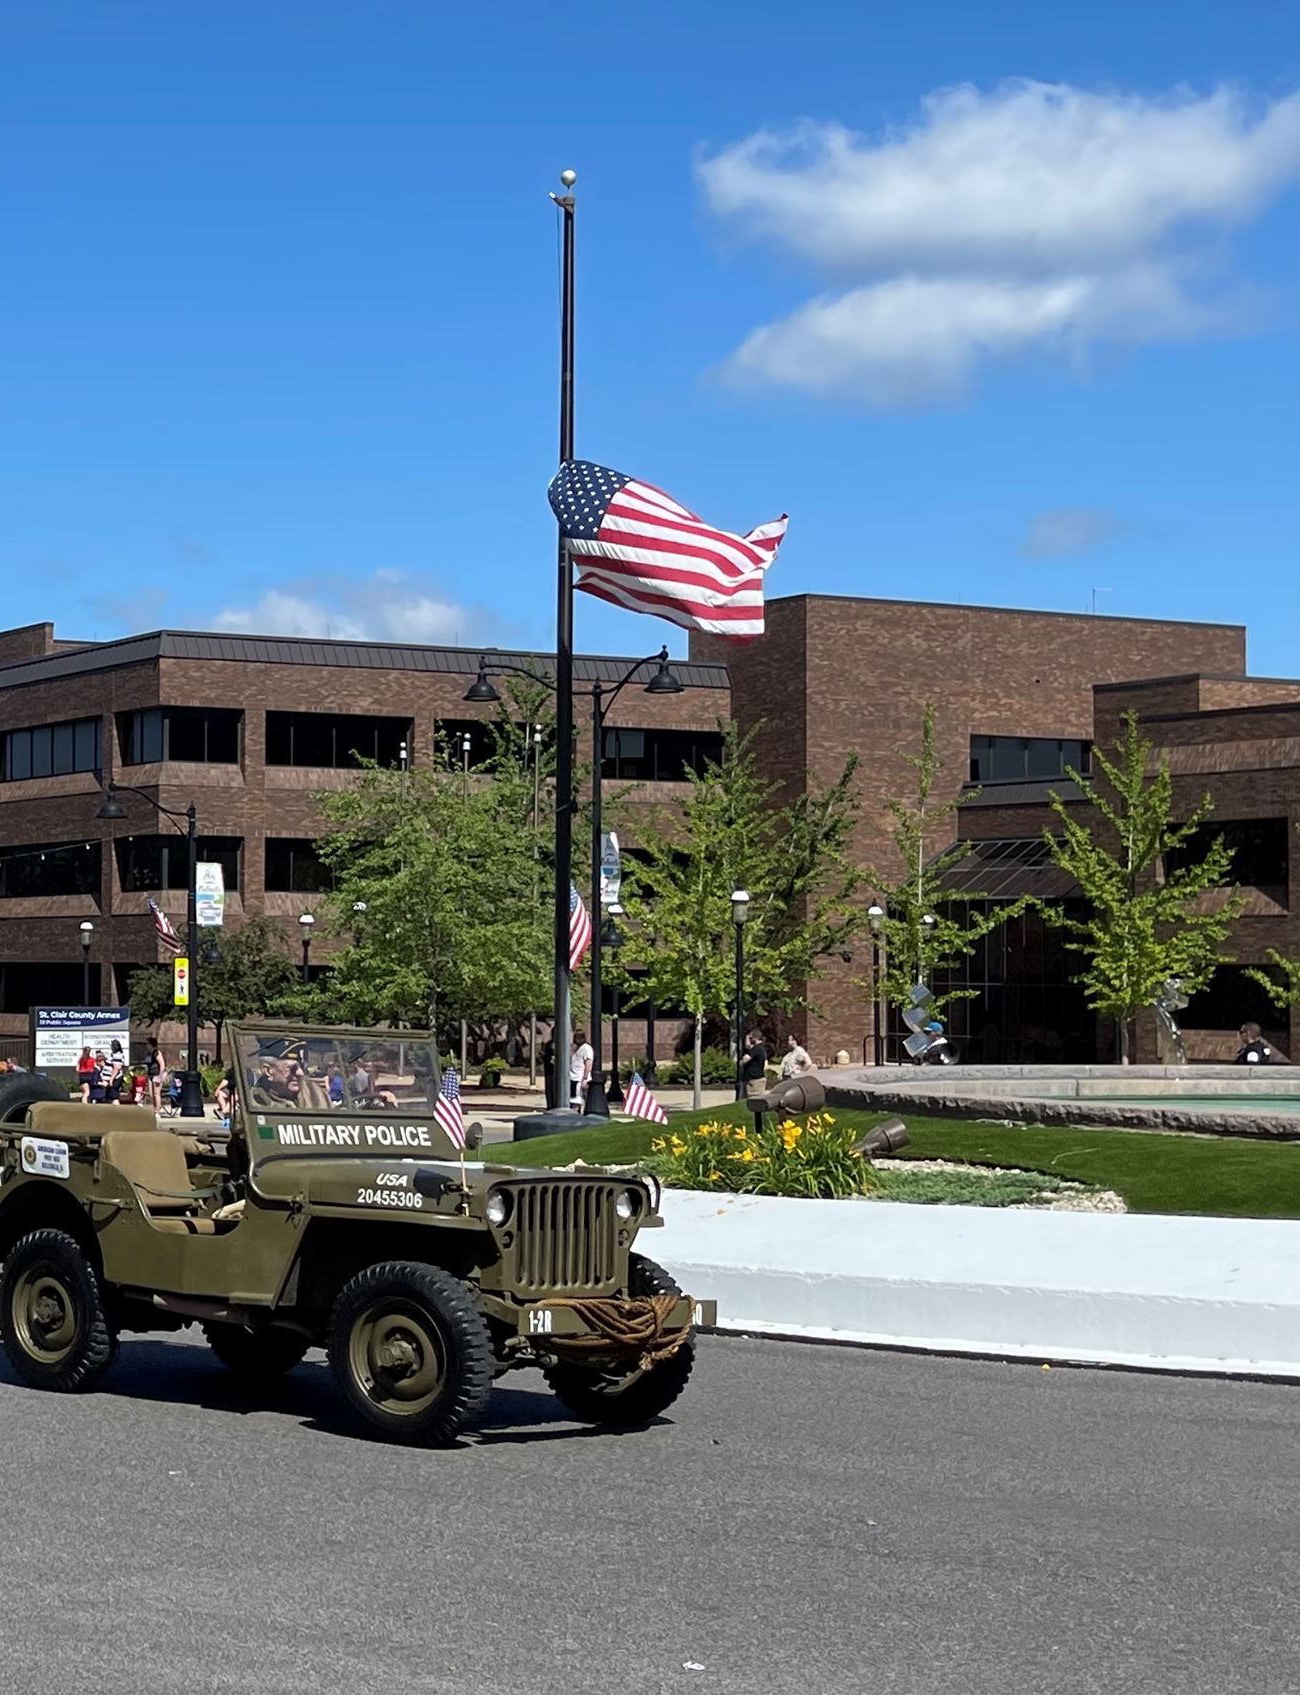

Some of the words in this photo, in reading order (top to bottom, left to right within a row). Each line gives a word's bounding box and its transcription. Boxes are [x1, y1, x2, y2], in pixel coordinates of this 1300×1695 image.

[39, 1011, 50, 1019] St.
[50, 1011, 68, 1019] Clair
[68, 1011, 95, 1020] County
[96, 1011, 121, 1019] Annex
[278, 1124, 360, 1145] MILITARY
[364, 1125, 432, 1147] POLICE
[376, 1172, 408, 1187] USA
[357, 1188, 423, 1208] 20455306
